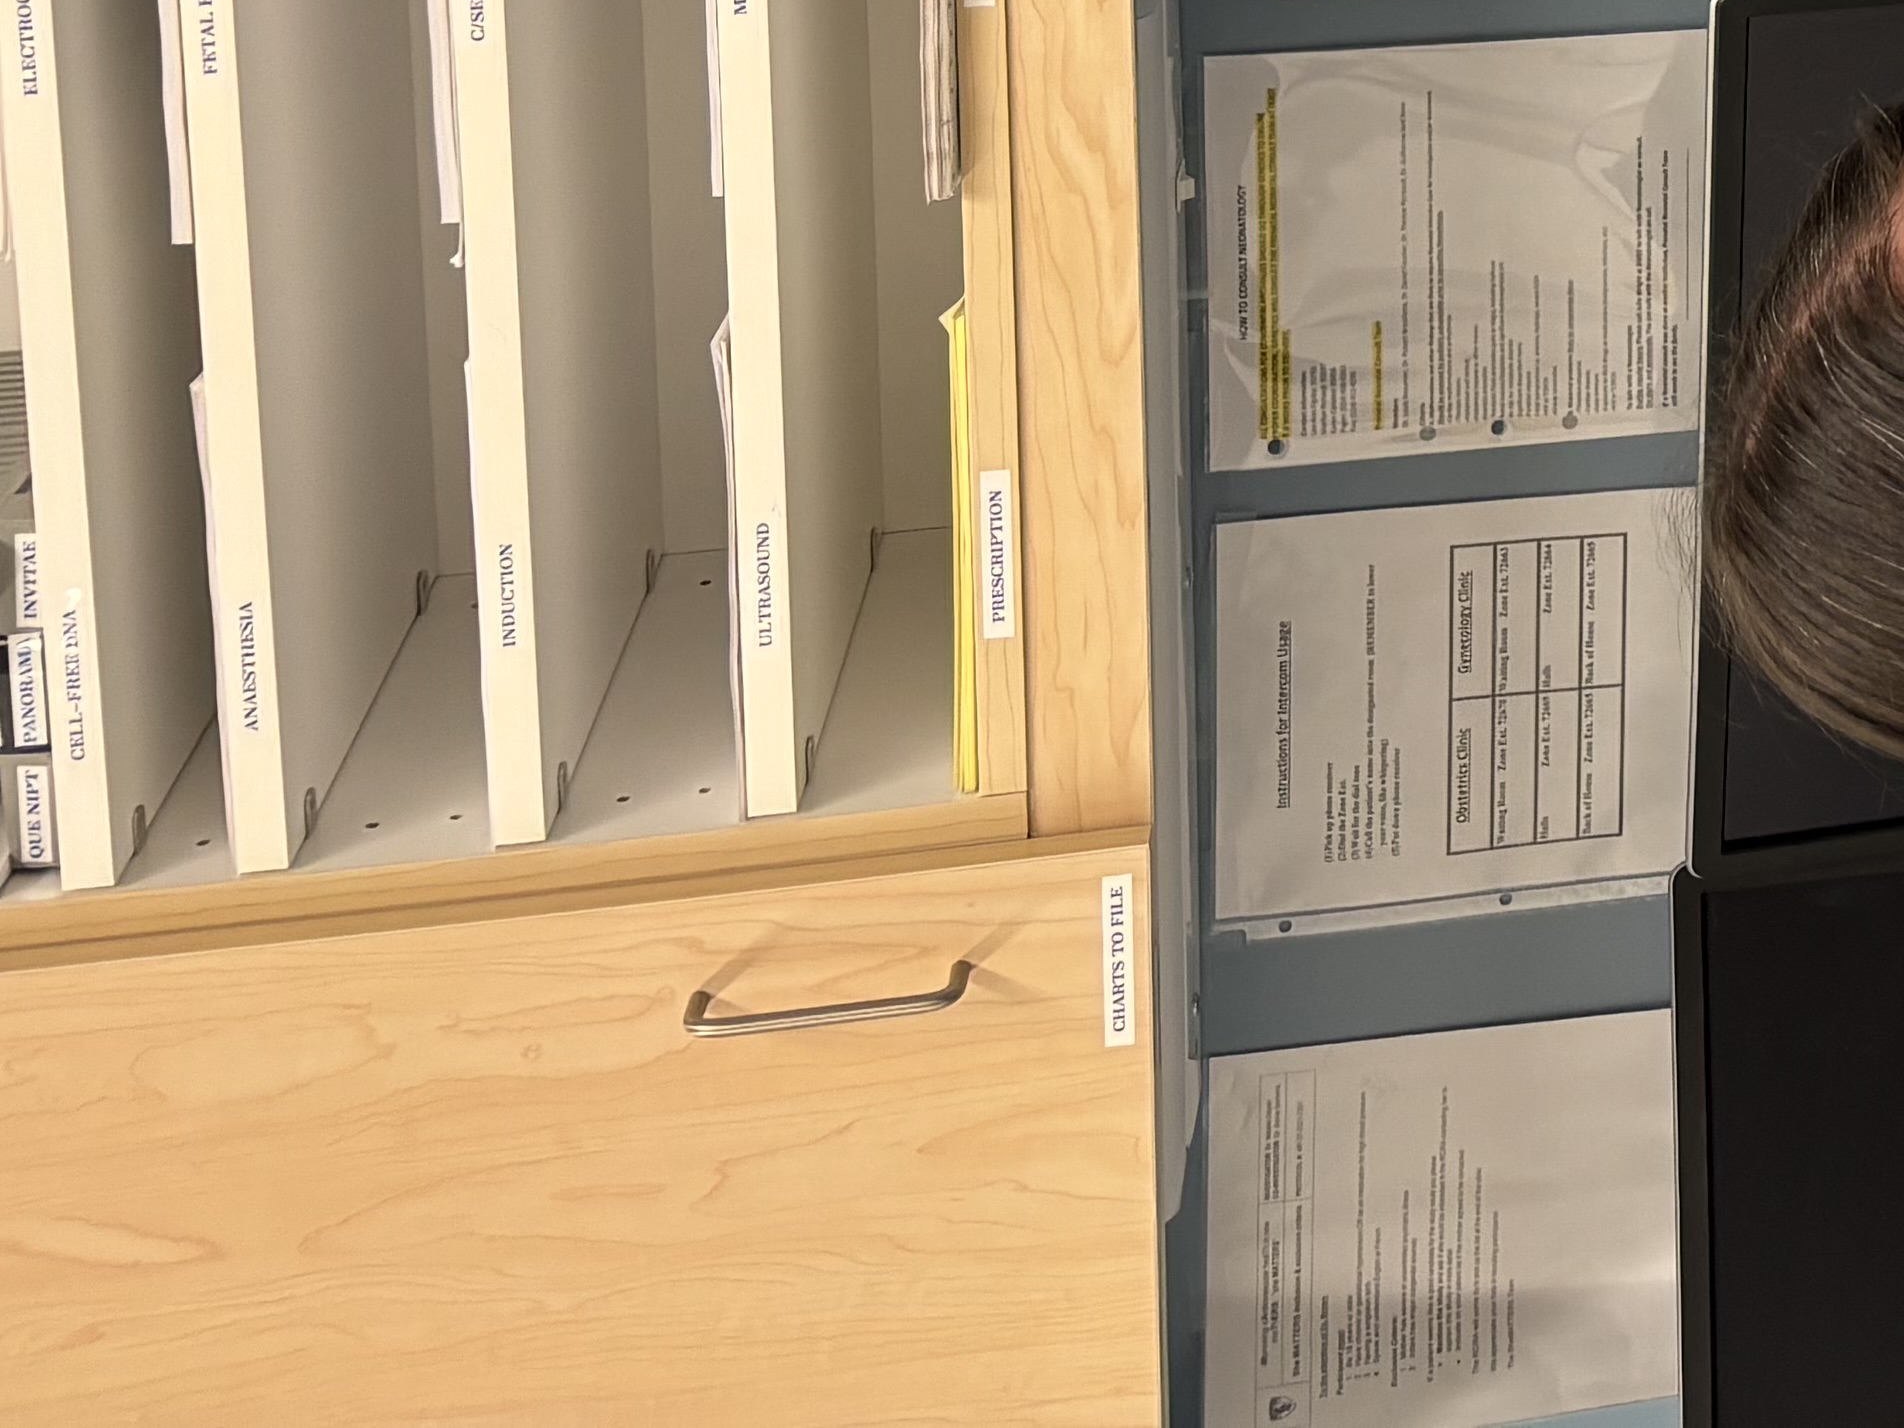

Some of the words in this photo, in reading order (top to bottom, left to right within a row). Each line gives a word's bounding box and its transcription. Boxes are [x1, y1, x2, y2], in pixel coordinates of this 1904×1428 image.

[198, 11, 218, 75] FETAL
[1237, 257, 1248, 300] CONSULT
[1237, 301, 1248, 316] TO
[1238, 315, 1249, 341] HOW
[21, 541, 38, 620] INVITAE
[988, 490, 1005, 624] PRESCRIPTION
[498, 544, 516, 648] INDUCTION
[755, 522, 773, 648] ULTRASOUND
[1457, 570, 1472, 603] Clinic
[61, 609, 79, 649] DNA
[1276, 620, 1291, 659] Usage
[1457, 604, 1473, 675] Gynecology
[238, 601, 259, 732] ANAESTHESIA
[1275, 659, 1290, 716] Intercom
[64, 653, 85, 761] CELL-FREE
[1275, 717, 1291, 737] for
[1455, 727, 1471, 761] Clinic
[25, 769, 41, 815] NIPT
[1275, 737, 1290, 809] Instructions
[1455, 761, 1471, 825] Obstetrics
[25, 820, 45, 859] QUE
[1109, 885, 1124, 928] FILE
[1110, 931, 1124, 959] TO
[1111, 960, 1126, 1033] CHARTS
